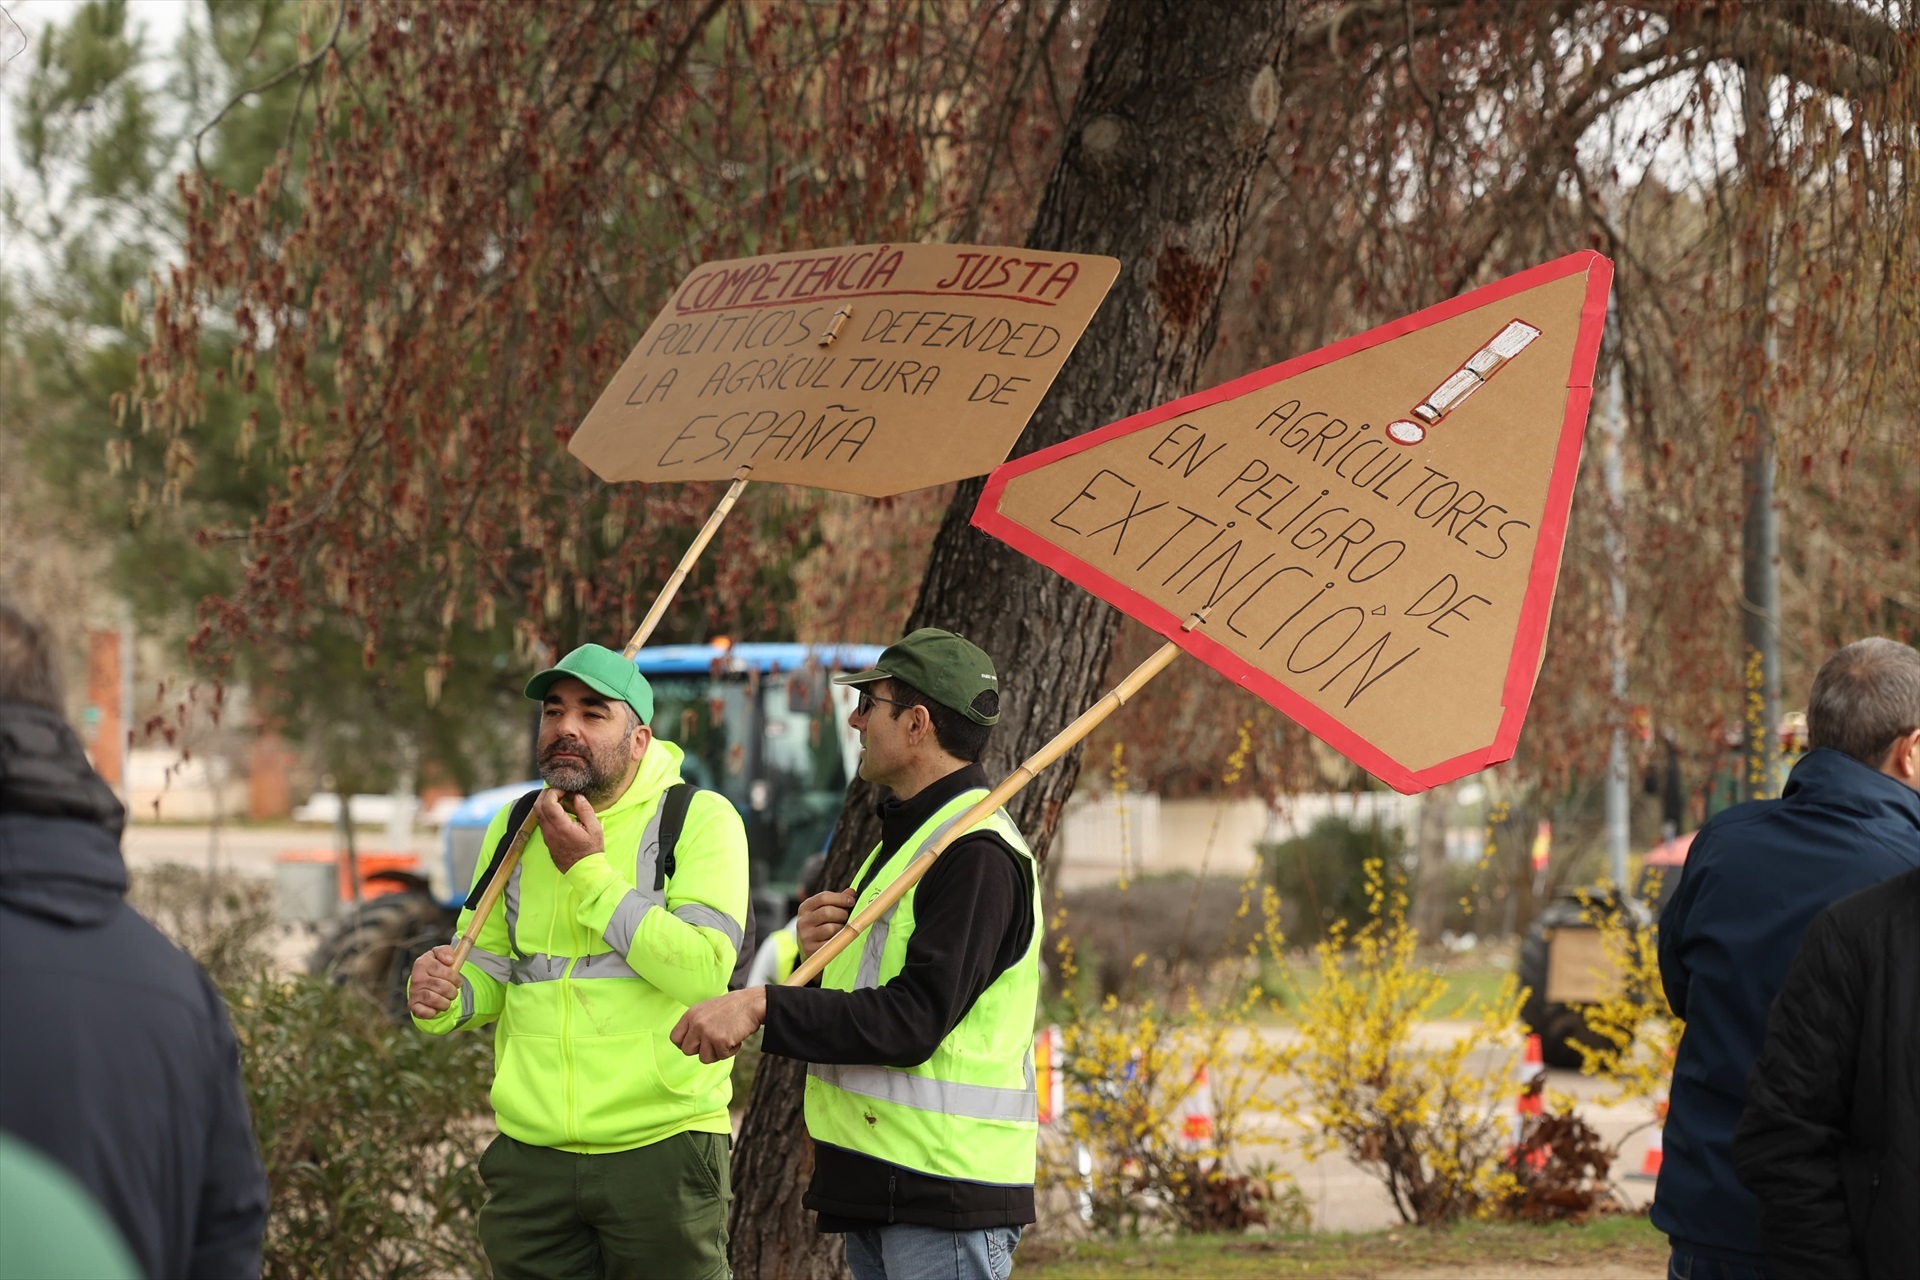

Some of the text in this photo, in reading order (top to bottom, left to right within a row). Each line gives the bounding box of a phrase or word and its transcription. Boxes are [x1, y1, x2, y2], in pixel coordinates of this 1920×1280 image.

[936, 253, 1080, 300] JUSTA
[861, 309, 1061, 358] DEFENDED
[624, 353, 1031, 406] LA AGRICULTURA DE
[657, 404, 876, 467] ESPAÑA
[1255, 400, 1531, 559] AGRICULTORES
[1148, 423, 1493, 638] EN PELIGRO DE
